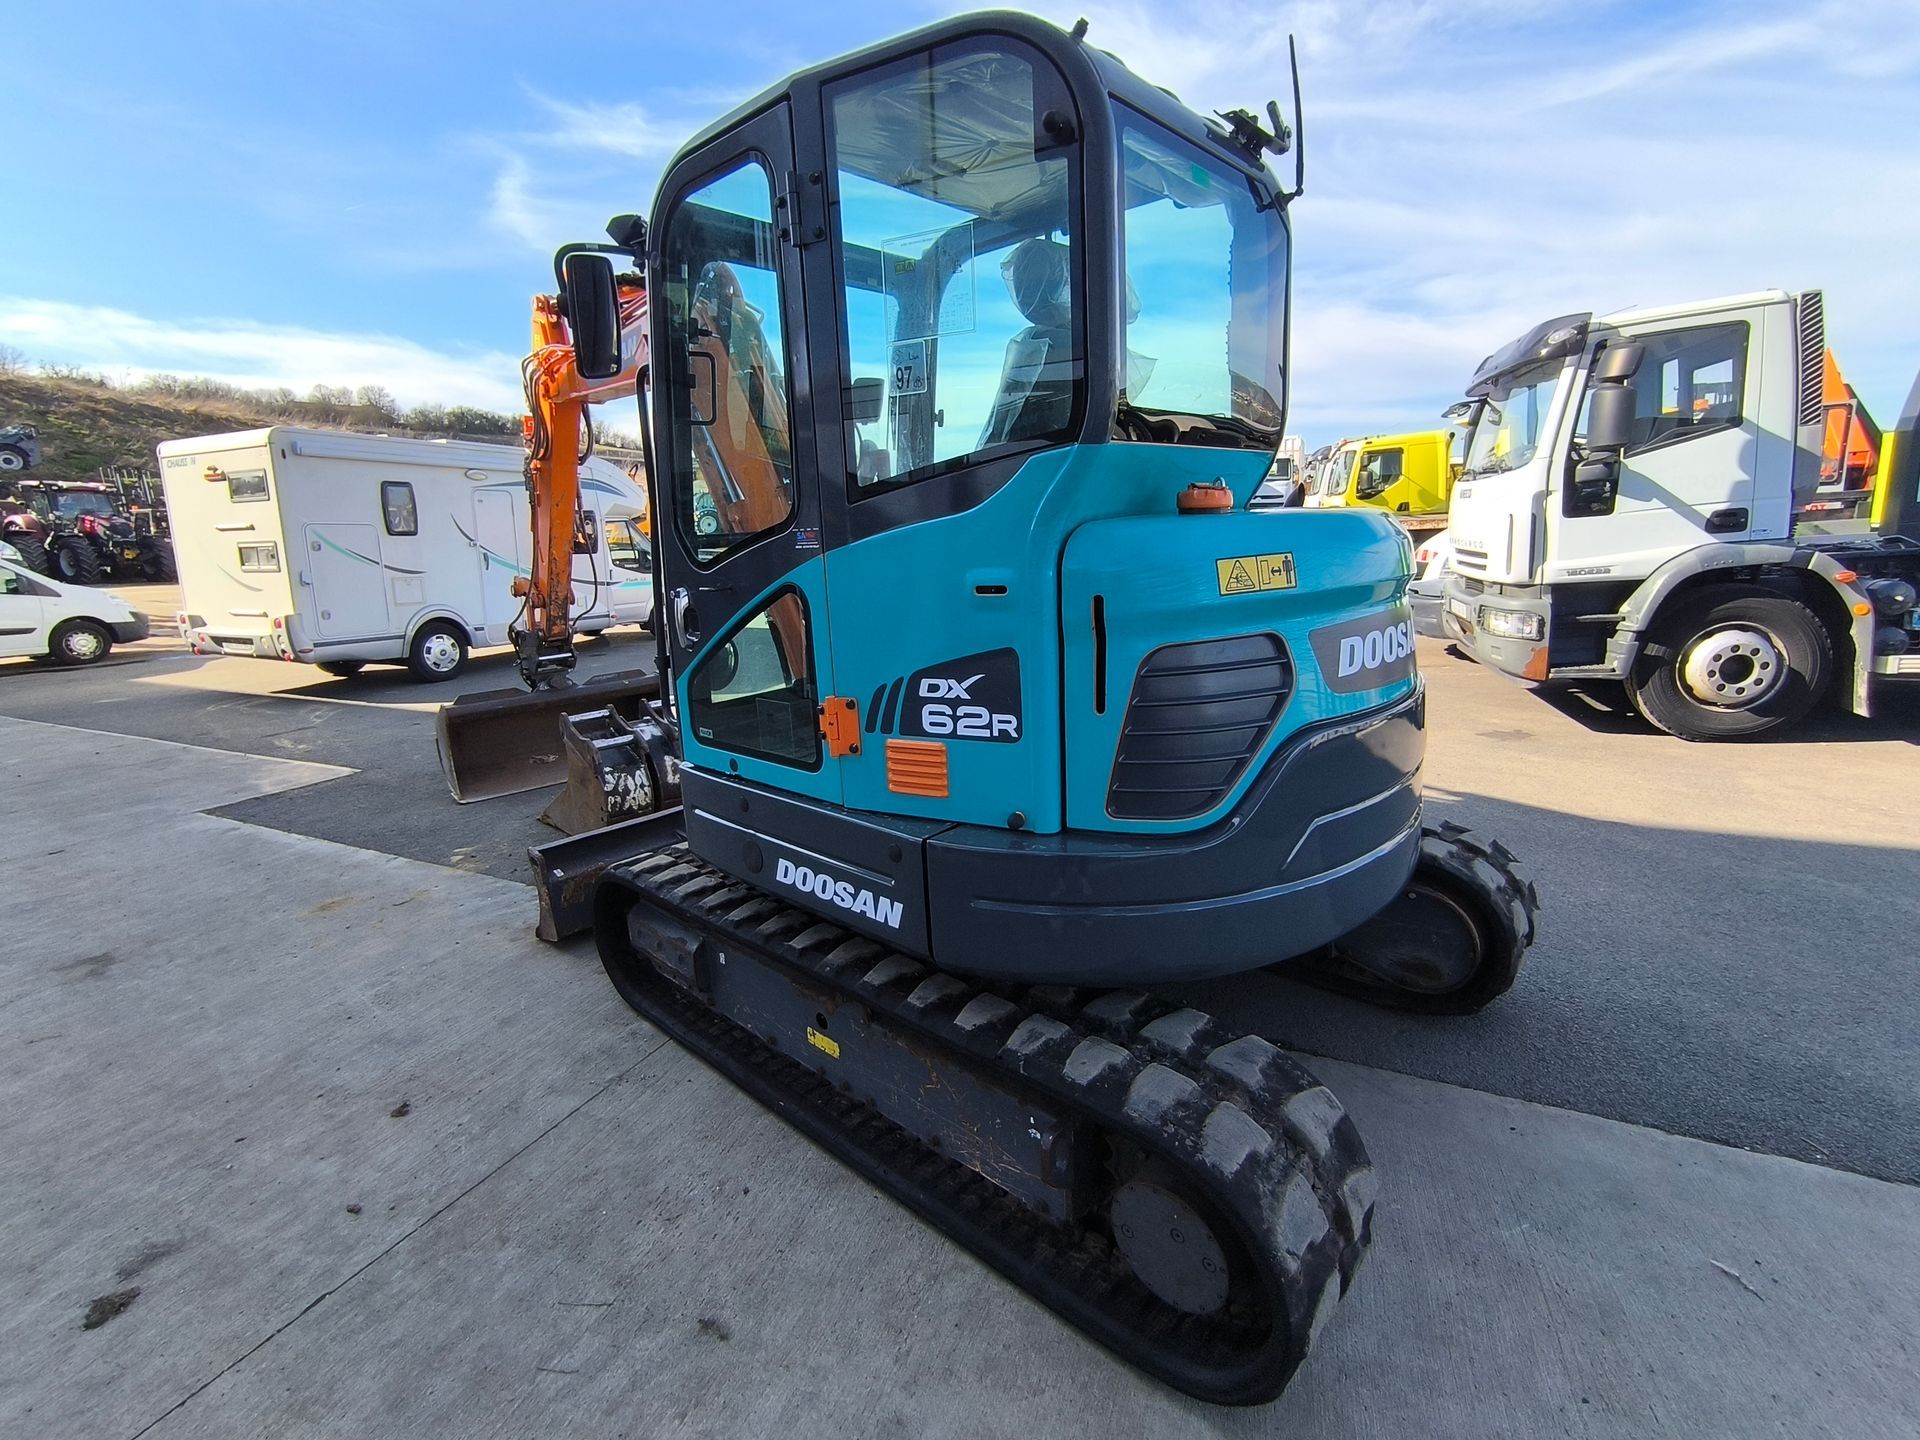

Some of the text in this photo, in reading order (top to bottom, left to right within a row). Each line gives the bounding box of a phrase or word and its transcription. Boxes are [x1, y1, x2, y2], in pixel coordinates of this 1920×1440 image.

[895, 365, 913, 390] 97
[166, 457, 196, 469] CHAUSSN
[1338, 619, 1415, 678] DOOSA
[919, 674, 986, 699] DX
[922, 703, 1019, 737] 62R
[776, 858, 903, 929] DOOSAN
